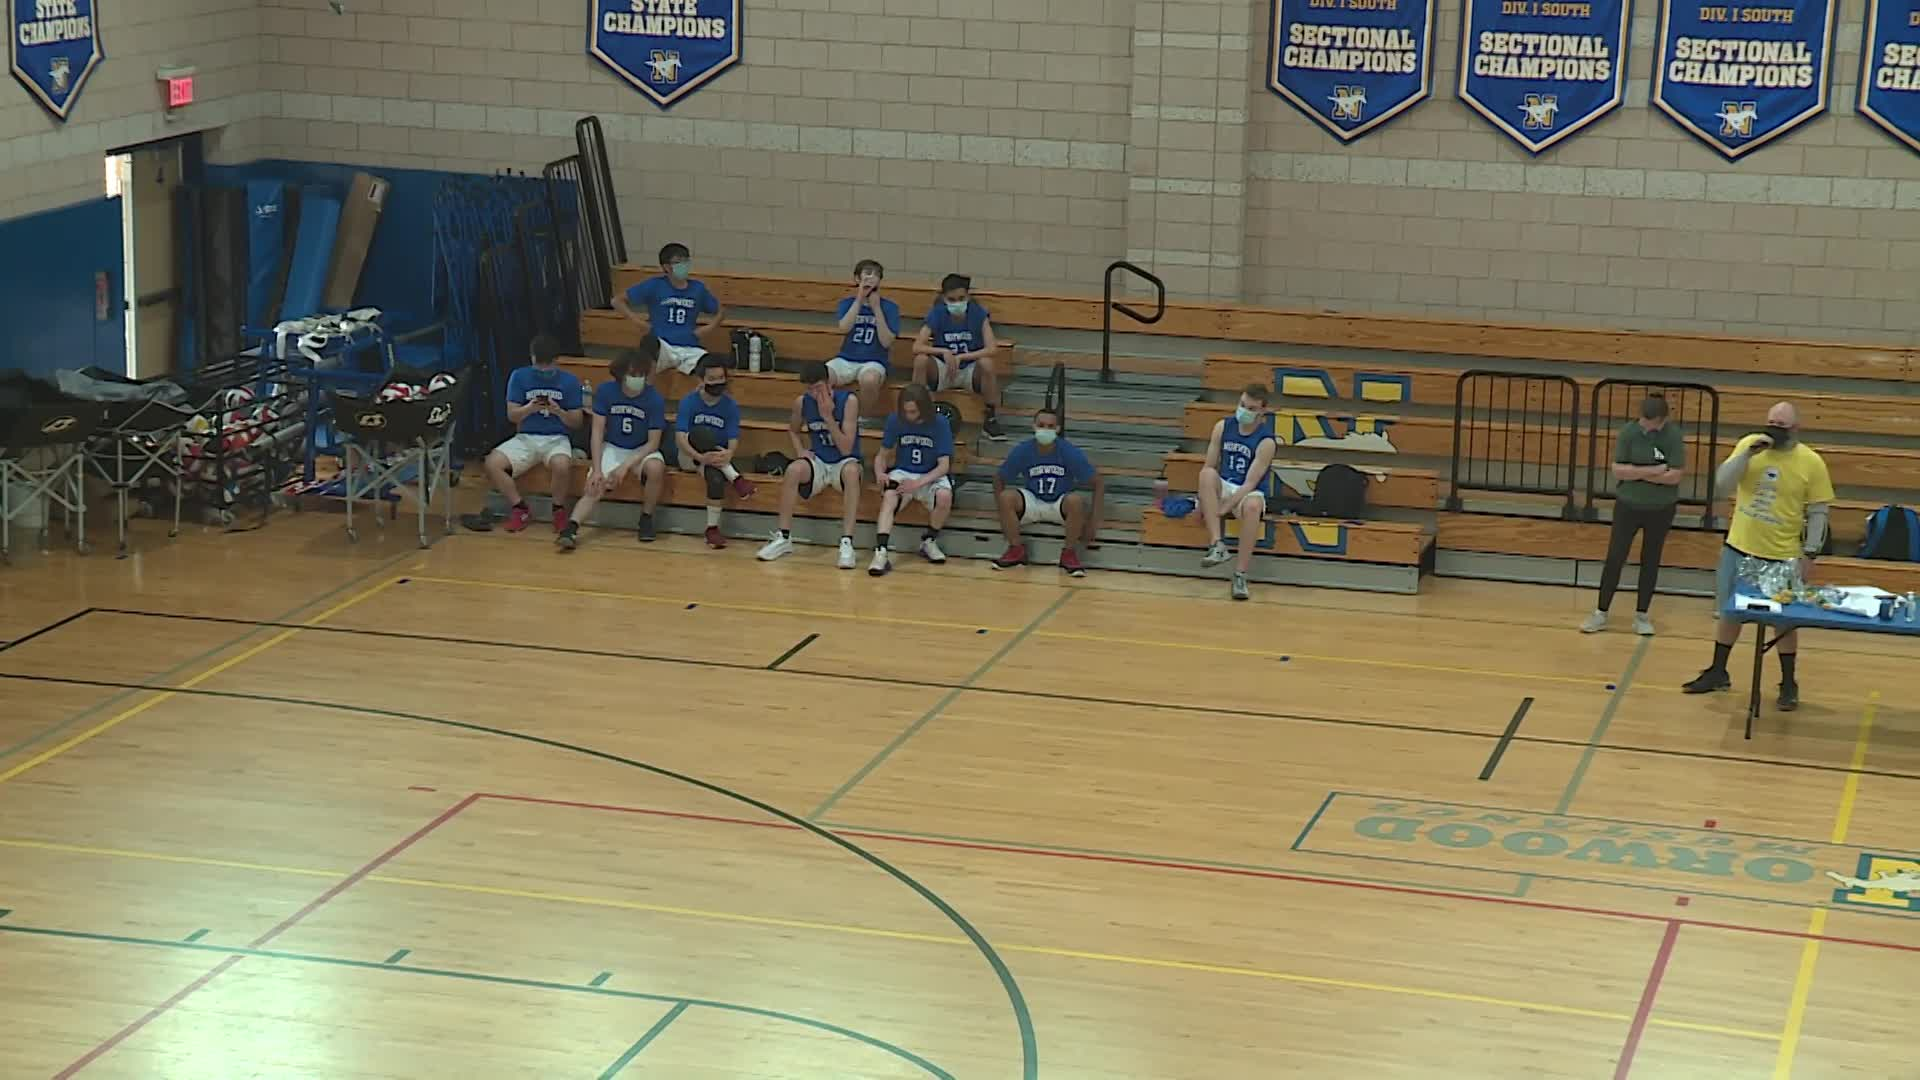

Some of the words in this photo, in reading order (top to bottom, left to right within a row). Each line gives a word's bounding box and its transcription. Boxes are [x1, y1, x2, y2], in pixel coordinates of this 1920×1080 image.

[36, 0, 76, 18] STATE
[631, 0, 697, 15] STATE
[1541, 3, 1591, 17] SOUTH
[1742, 8, 1794, 24] SOUTH
[19, 16, 91, 46] CHAMPIONS
[603, 11, 726, 39] CHAMPIONS
[1289, 23, 1416, 50] SECTIONAL
[1480, 31, 1609, 58] SECTIONAL
[1675, 37, 1812, 64] SECTIONAL
[1283, 46, 1417, 74] CHAMPIONS
[1474, 53, 1611, 81] CHAMPIONS
[1668, 60, 1813, 88] CHAMPIONS
[667, 307, 686, 324] 18
[853, 327, 875, 344] 20
[622, 417, 633, 433] 6
[911, 449, 922, 464] 9
[1229, 454, 1246, 474] 12
[1029, 464, 1065, 477] NORWOOD
[1038, 477, 1056, 494] 17
